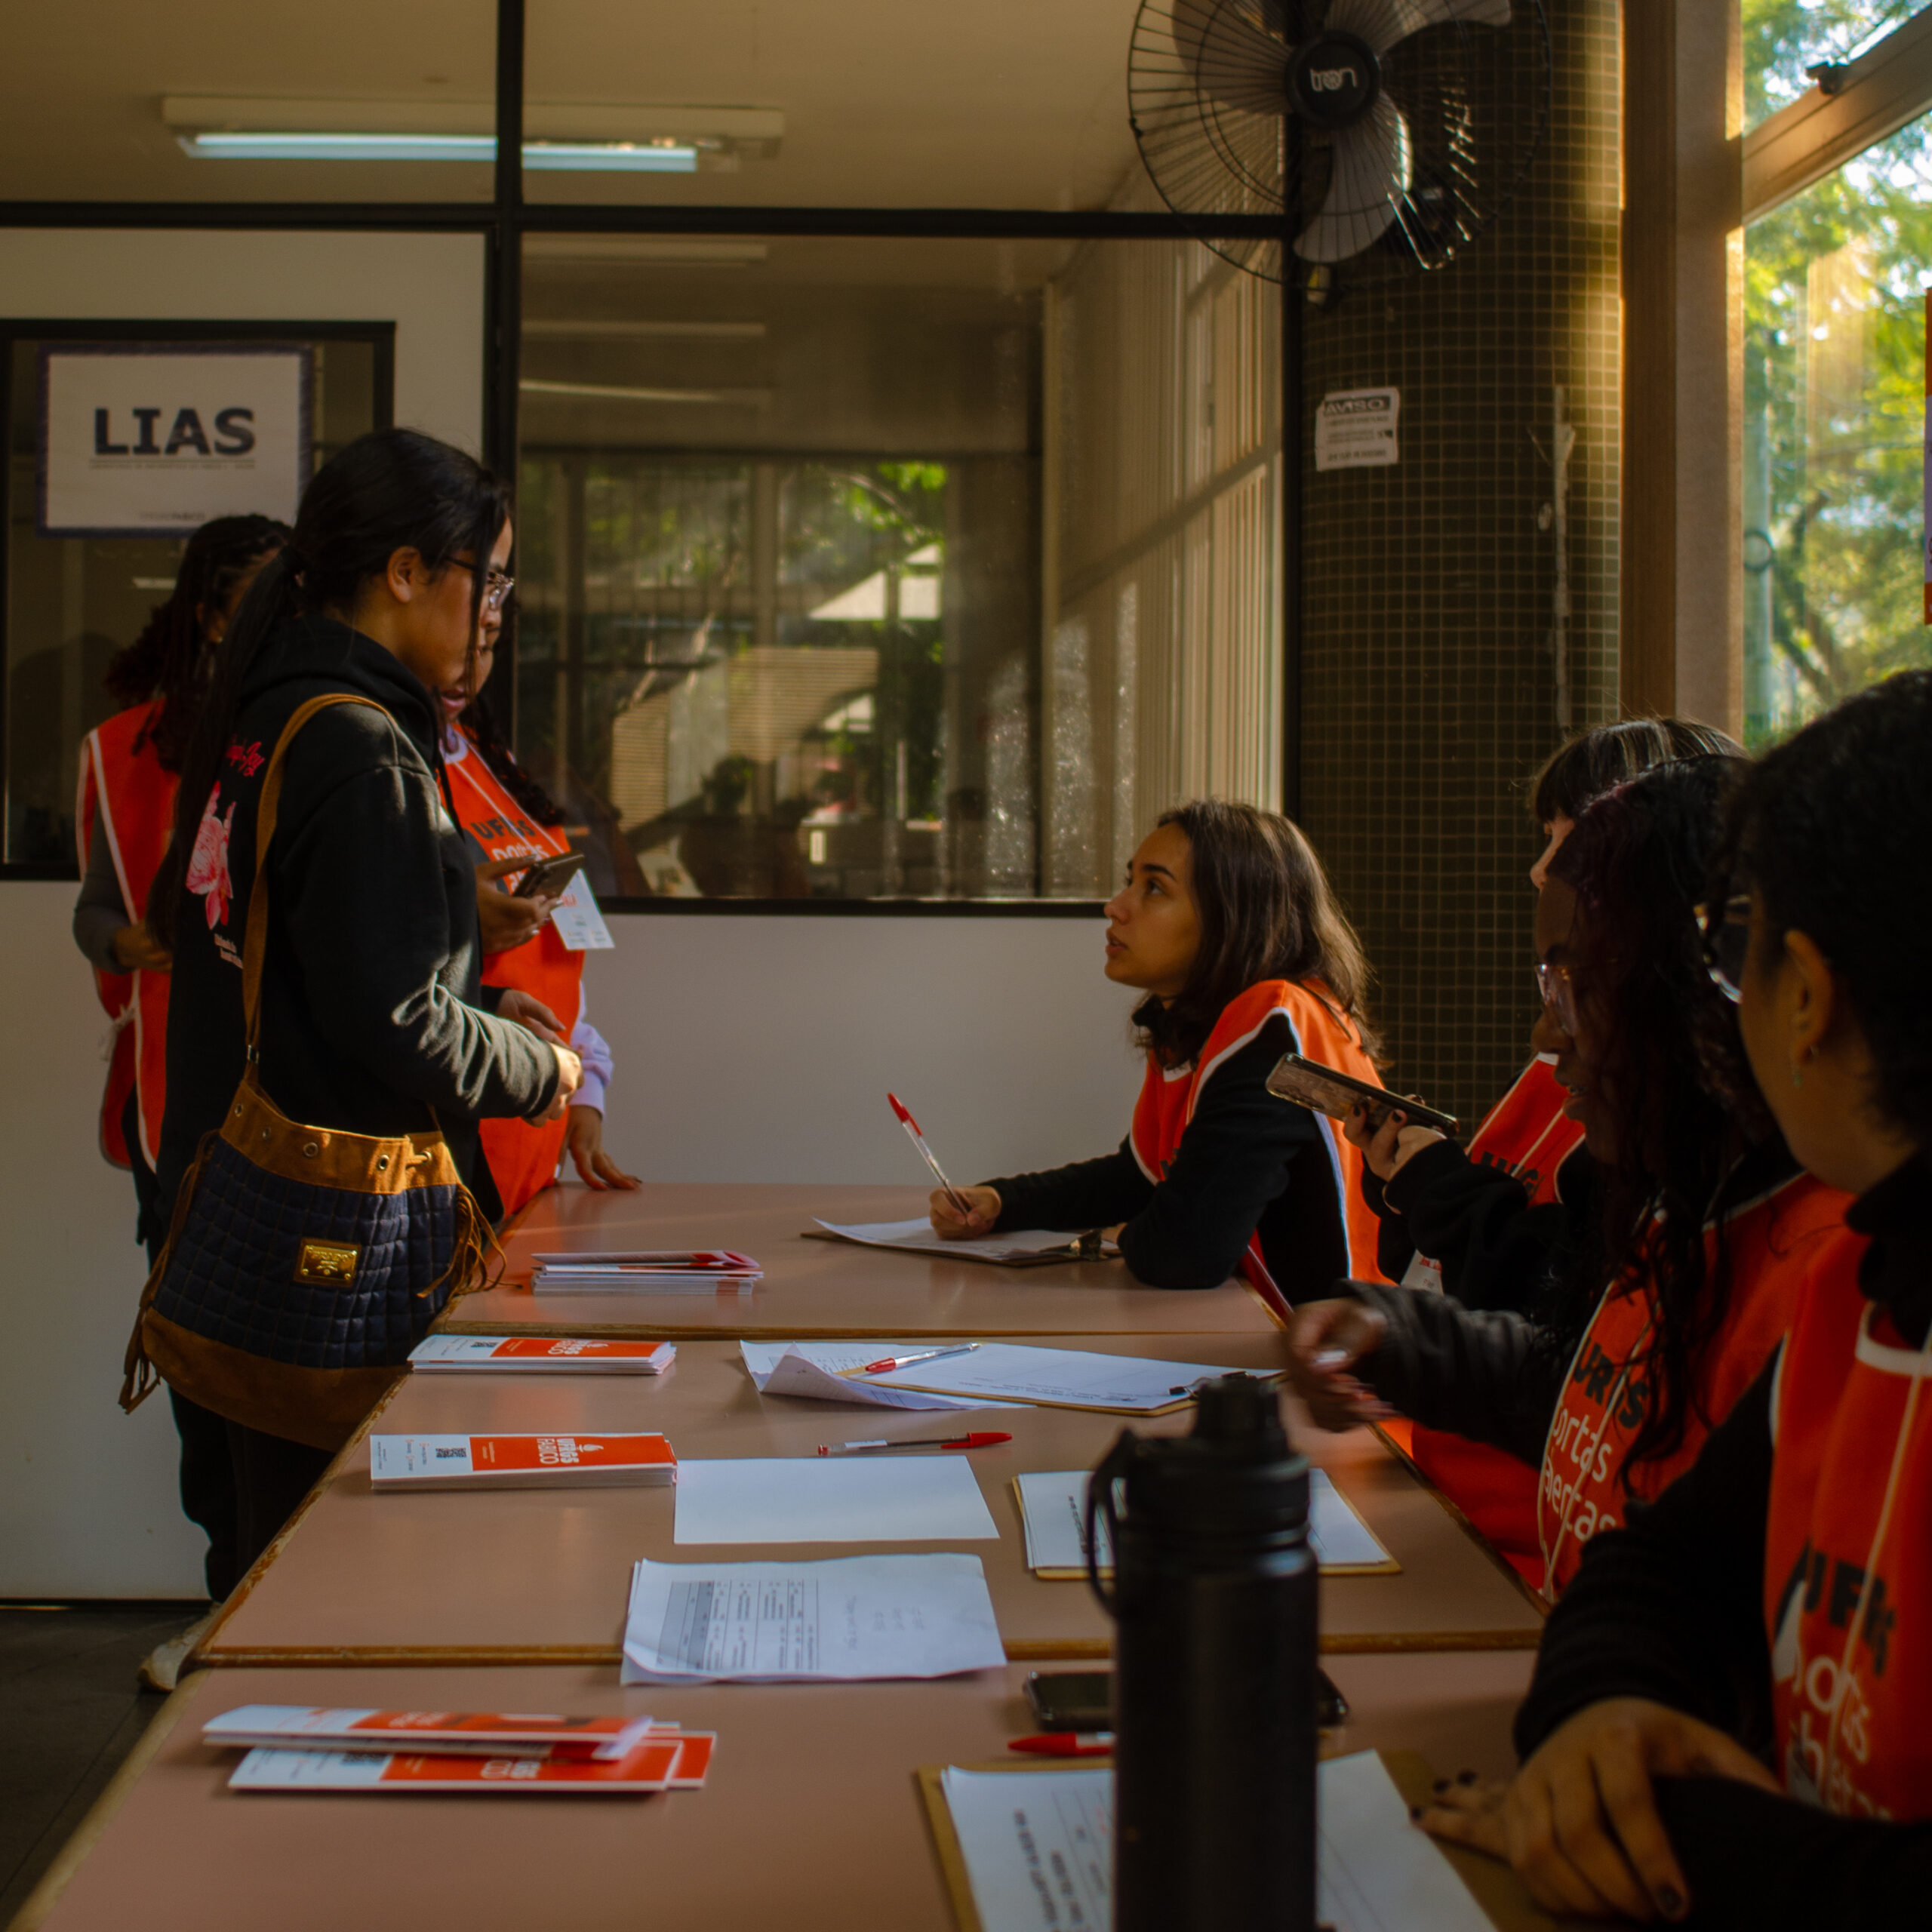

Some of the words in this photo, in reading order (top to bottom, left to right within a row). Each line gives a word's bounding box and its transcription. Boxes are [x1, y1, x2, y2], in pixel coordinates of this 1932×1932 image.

[1324, 398, 1384, 414] AVISO
[94, 408, 256, 456] LIAS
[537, 1438, 559, 1465] FABICO
[556, 1438, 580, 1463] UFRGS
